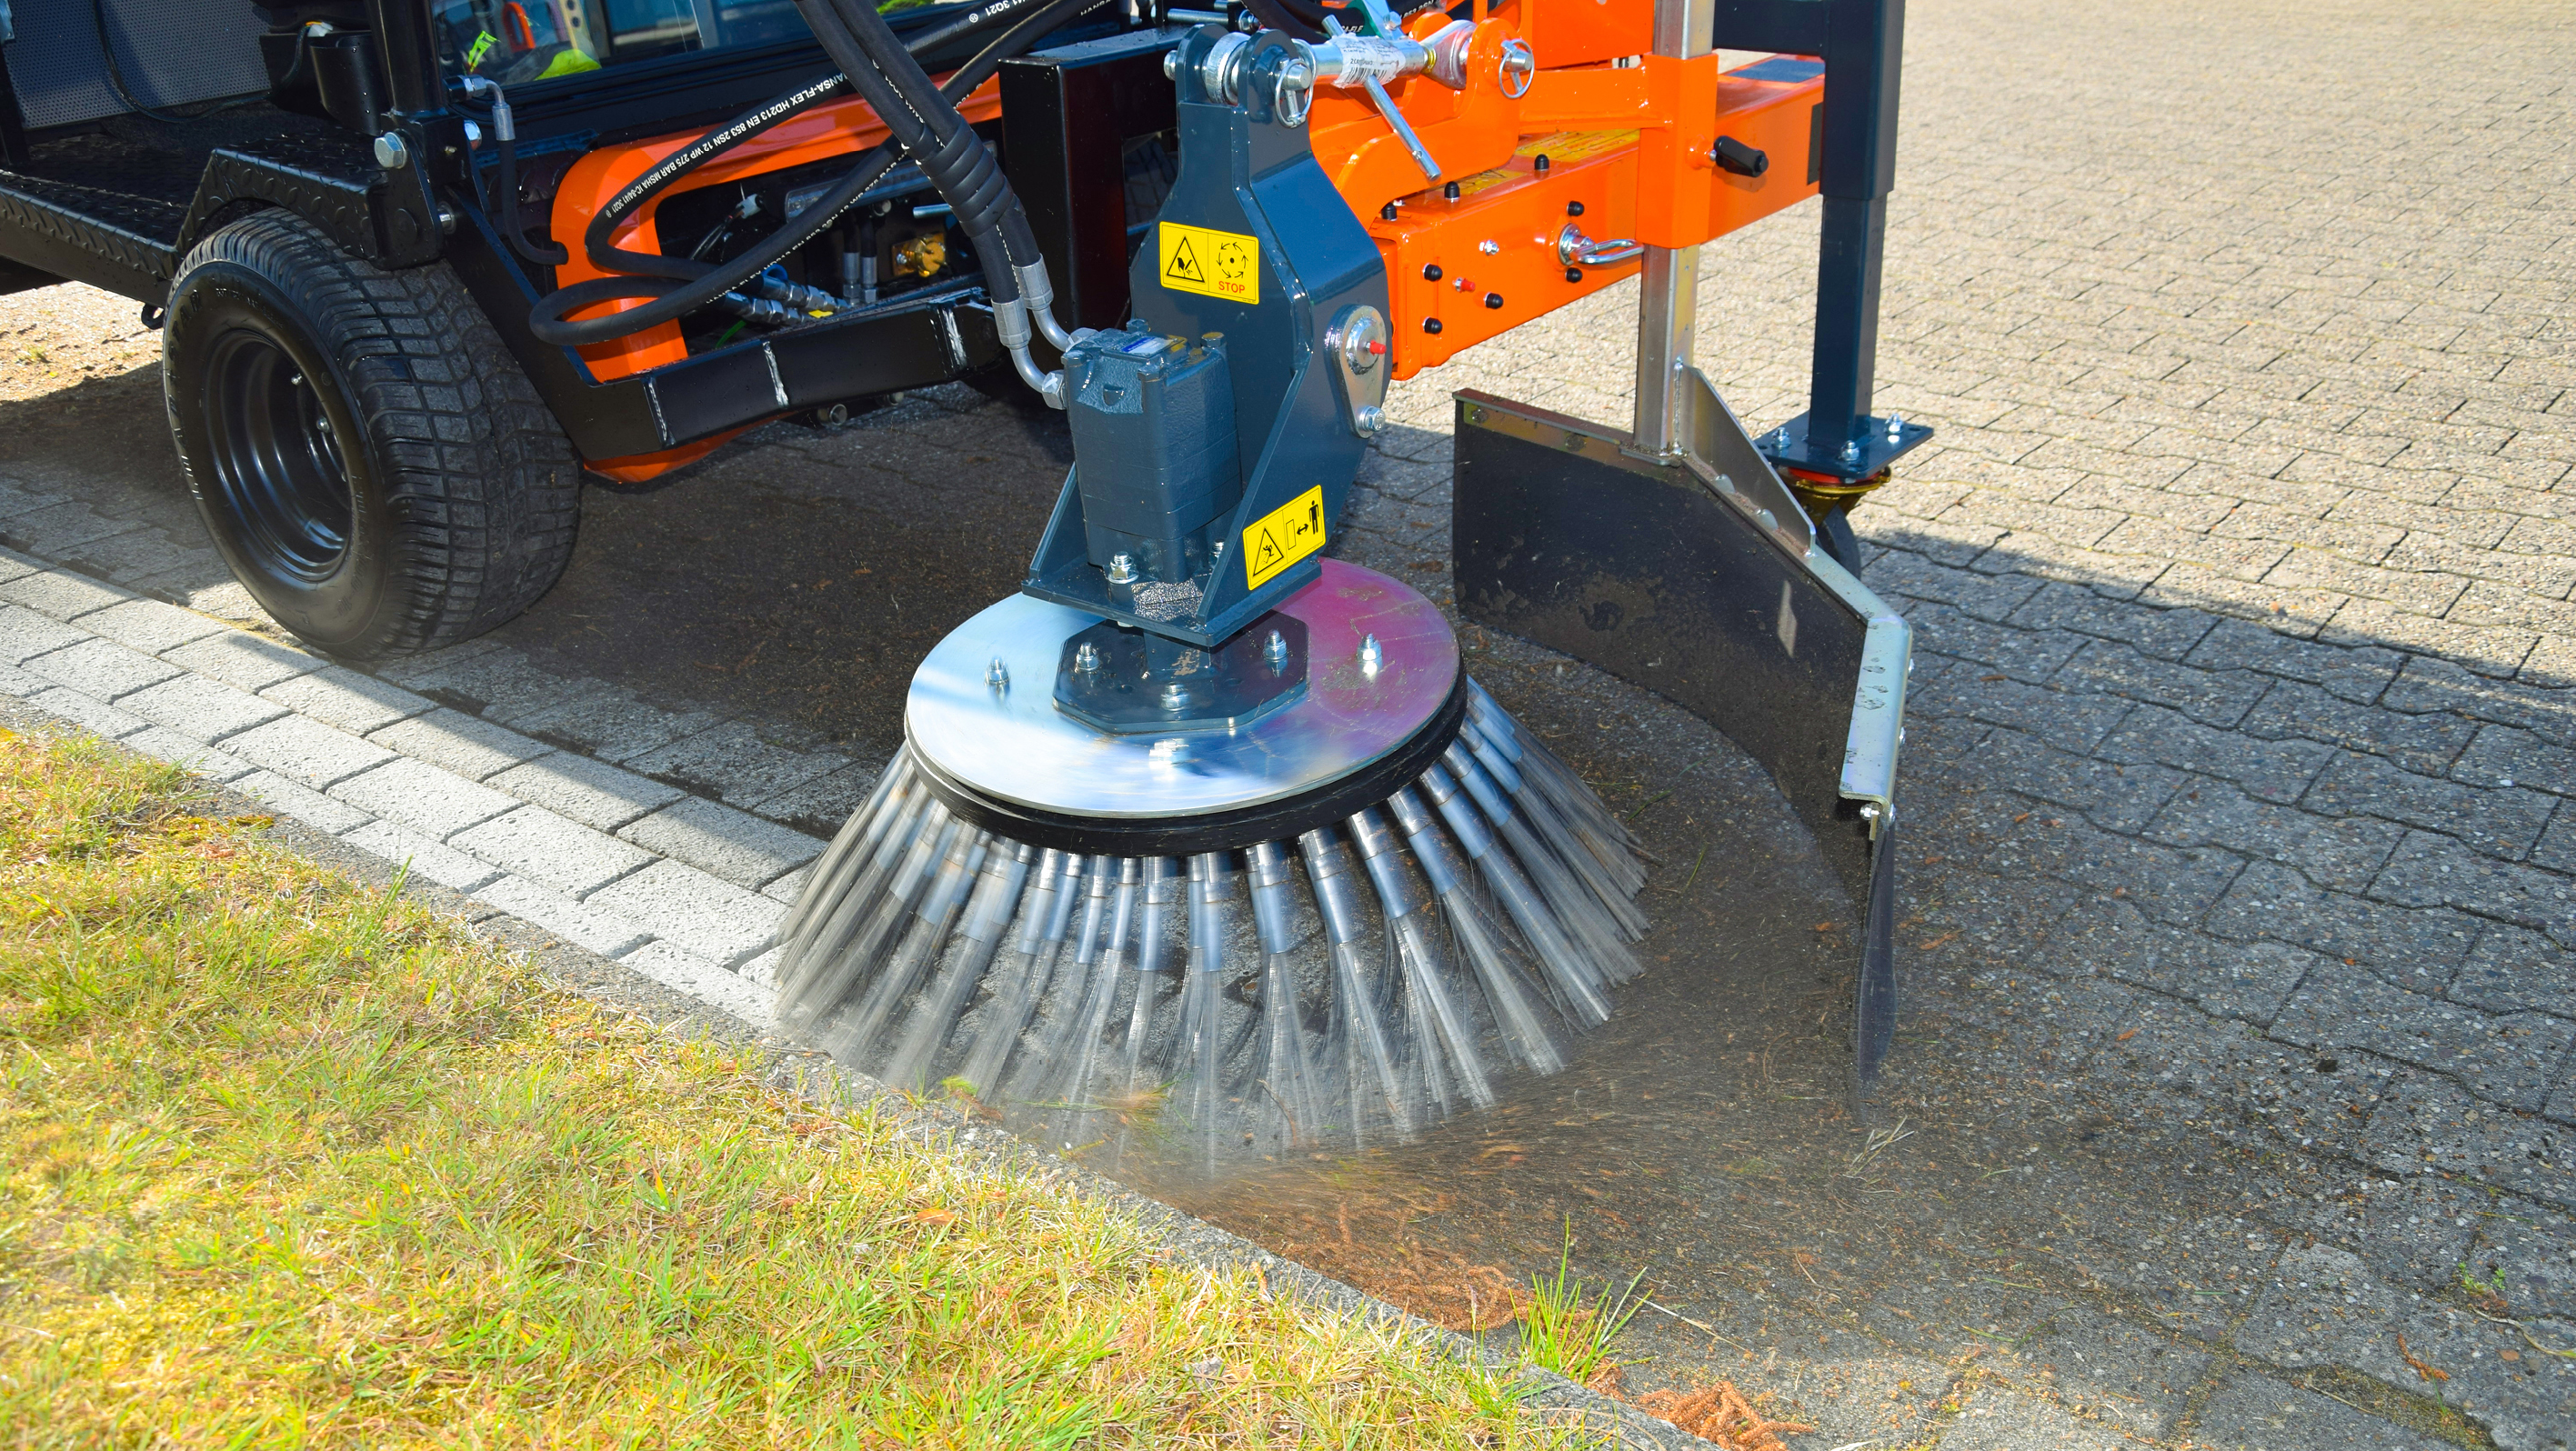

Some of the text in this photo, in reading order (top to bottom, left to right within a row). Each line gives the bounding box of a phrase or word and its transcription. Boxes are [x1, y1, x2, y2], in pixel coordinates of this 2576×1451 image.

[760, 100, 790, 121] HD213
[747, 115, 761, 129] EN
[730, 123, 747, 137] 853
[713, 131, 731, 146] 2SN
[690, 149, 705, 159] WP
[702, 142, 713, 153] 12
[676, 154, 690, 166] 275
[660, 162, 677, 177] BAR
[642, 172, 662, 189] MSHA
[1218, 281, 1246, 295] STOP
